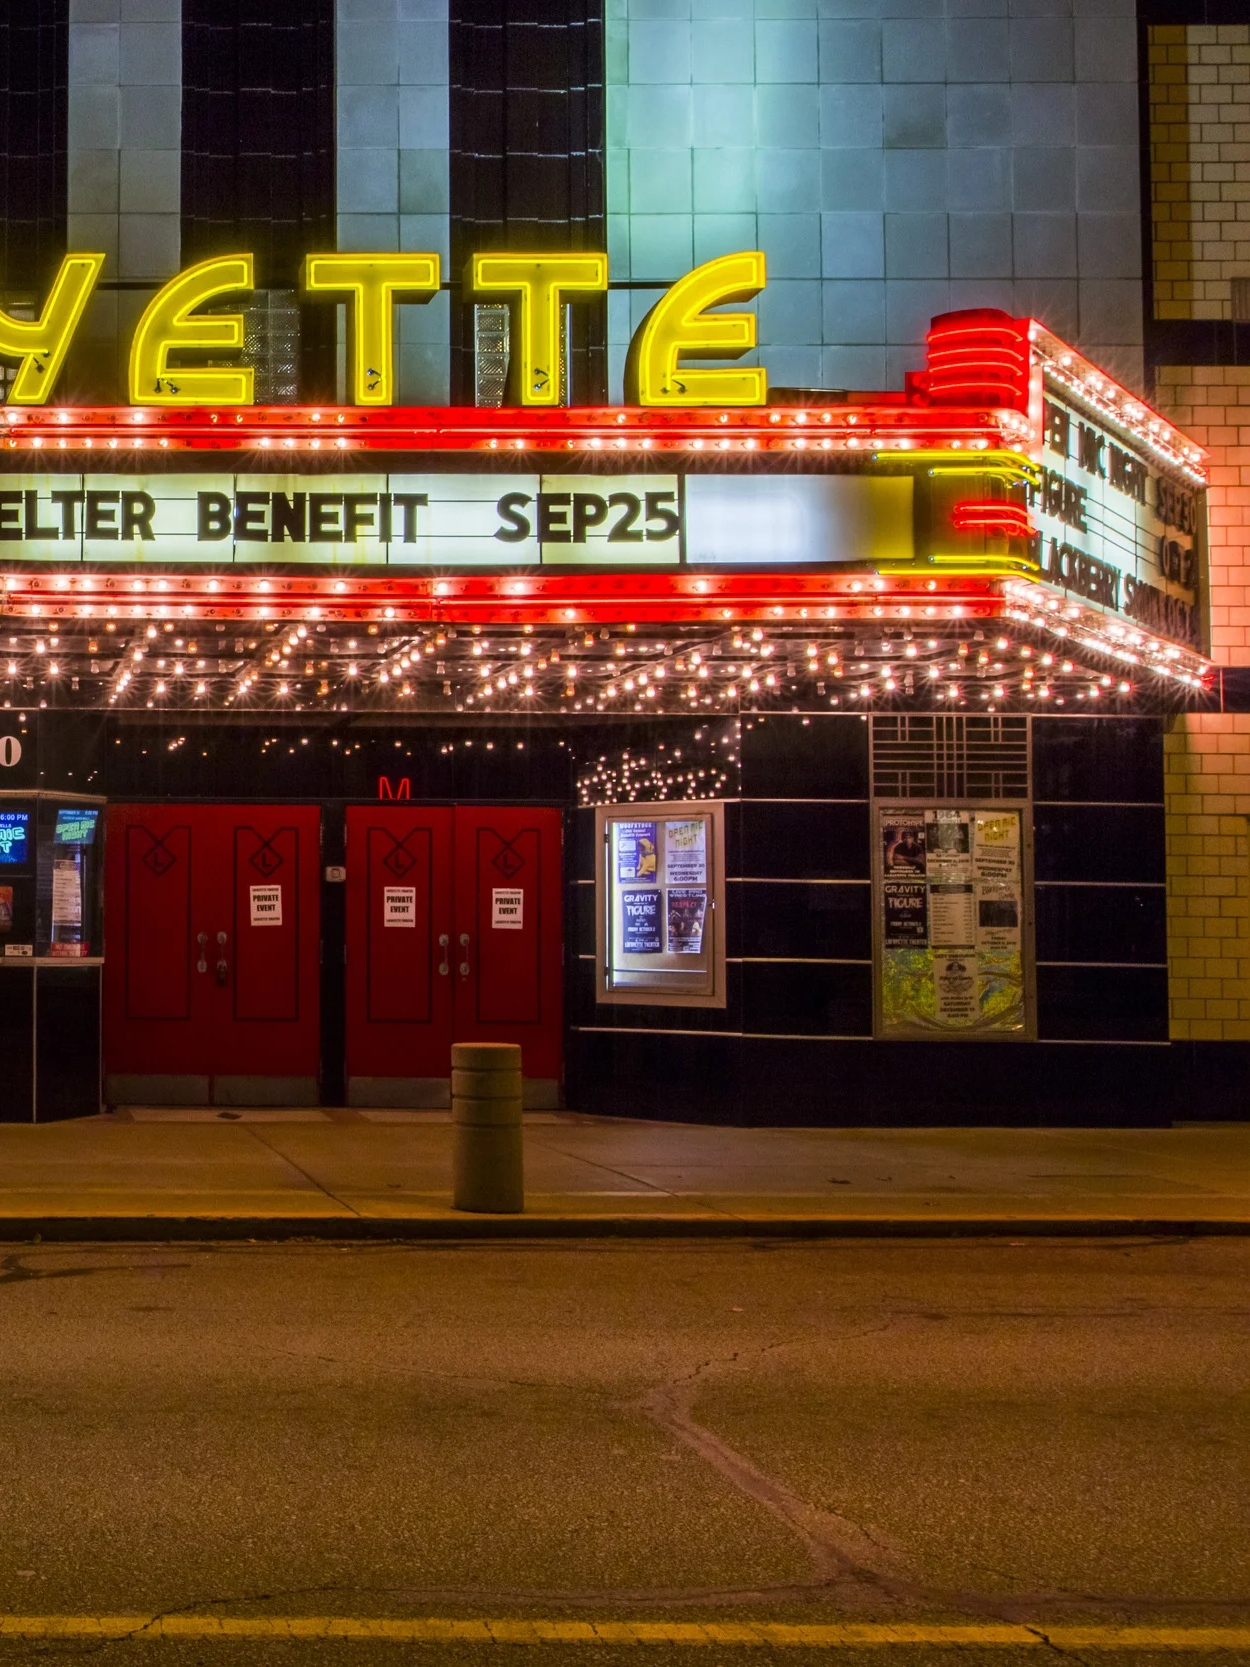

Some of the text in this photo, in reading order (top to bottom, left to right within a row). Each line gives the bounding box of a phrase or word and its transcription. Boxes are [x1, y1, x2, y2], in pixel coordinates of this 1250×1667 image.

[1108, 442, 1148, 507] NIGHT
[197, 490, 429, 543] BENEFIT
[493, 491, 680, 543] SEP25
[885, 885, 926, 893] GRAVITY
[253, 894, 279, 902] PRIVATE
[386, 895, 413, 903] PRIVATE
[495, 897, 521, 905] PRIVATE
[624, 894, 659, 902] GRAVITY
[257, 904, 276, 912] EVENT
[390, 905, 409, 913] EVENT
[499, 907, 518, 915] EVENT
